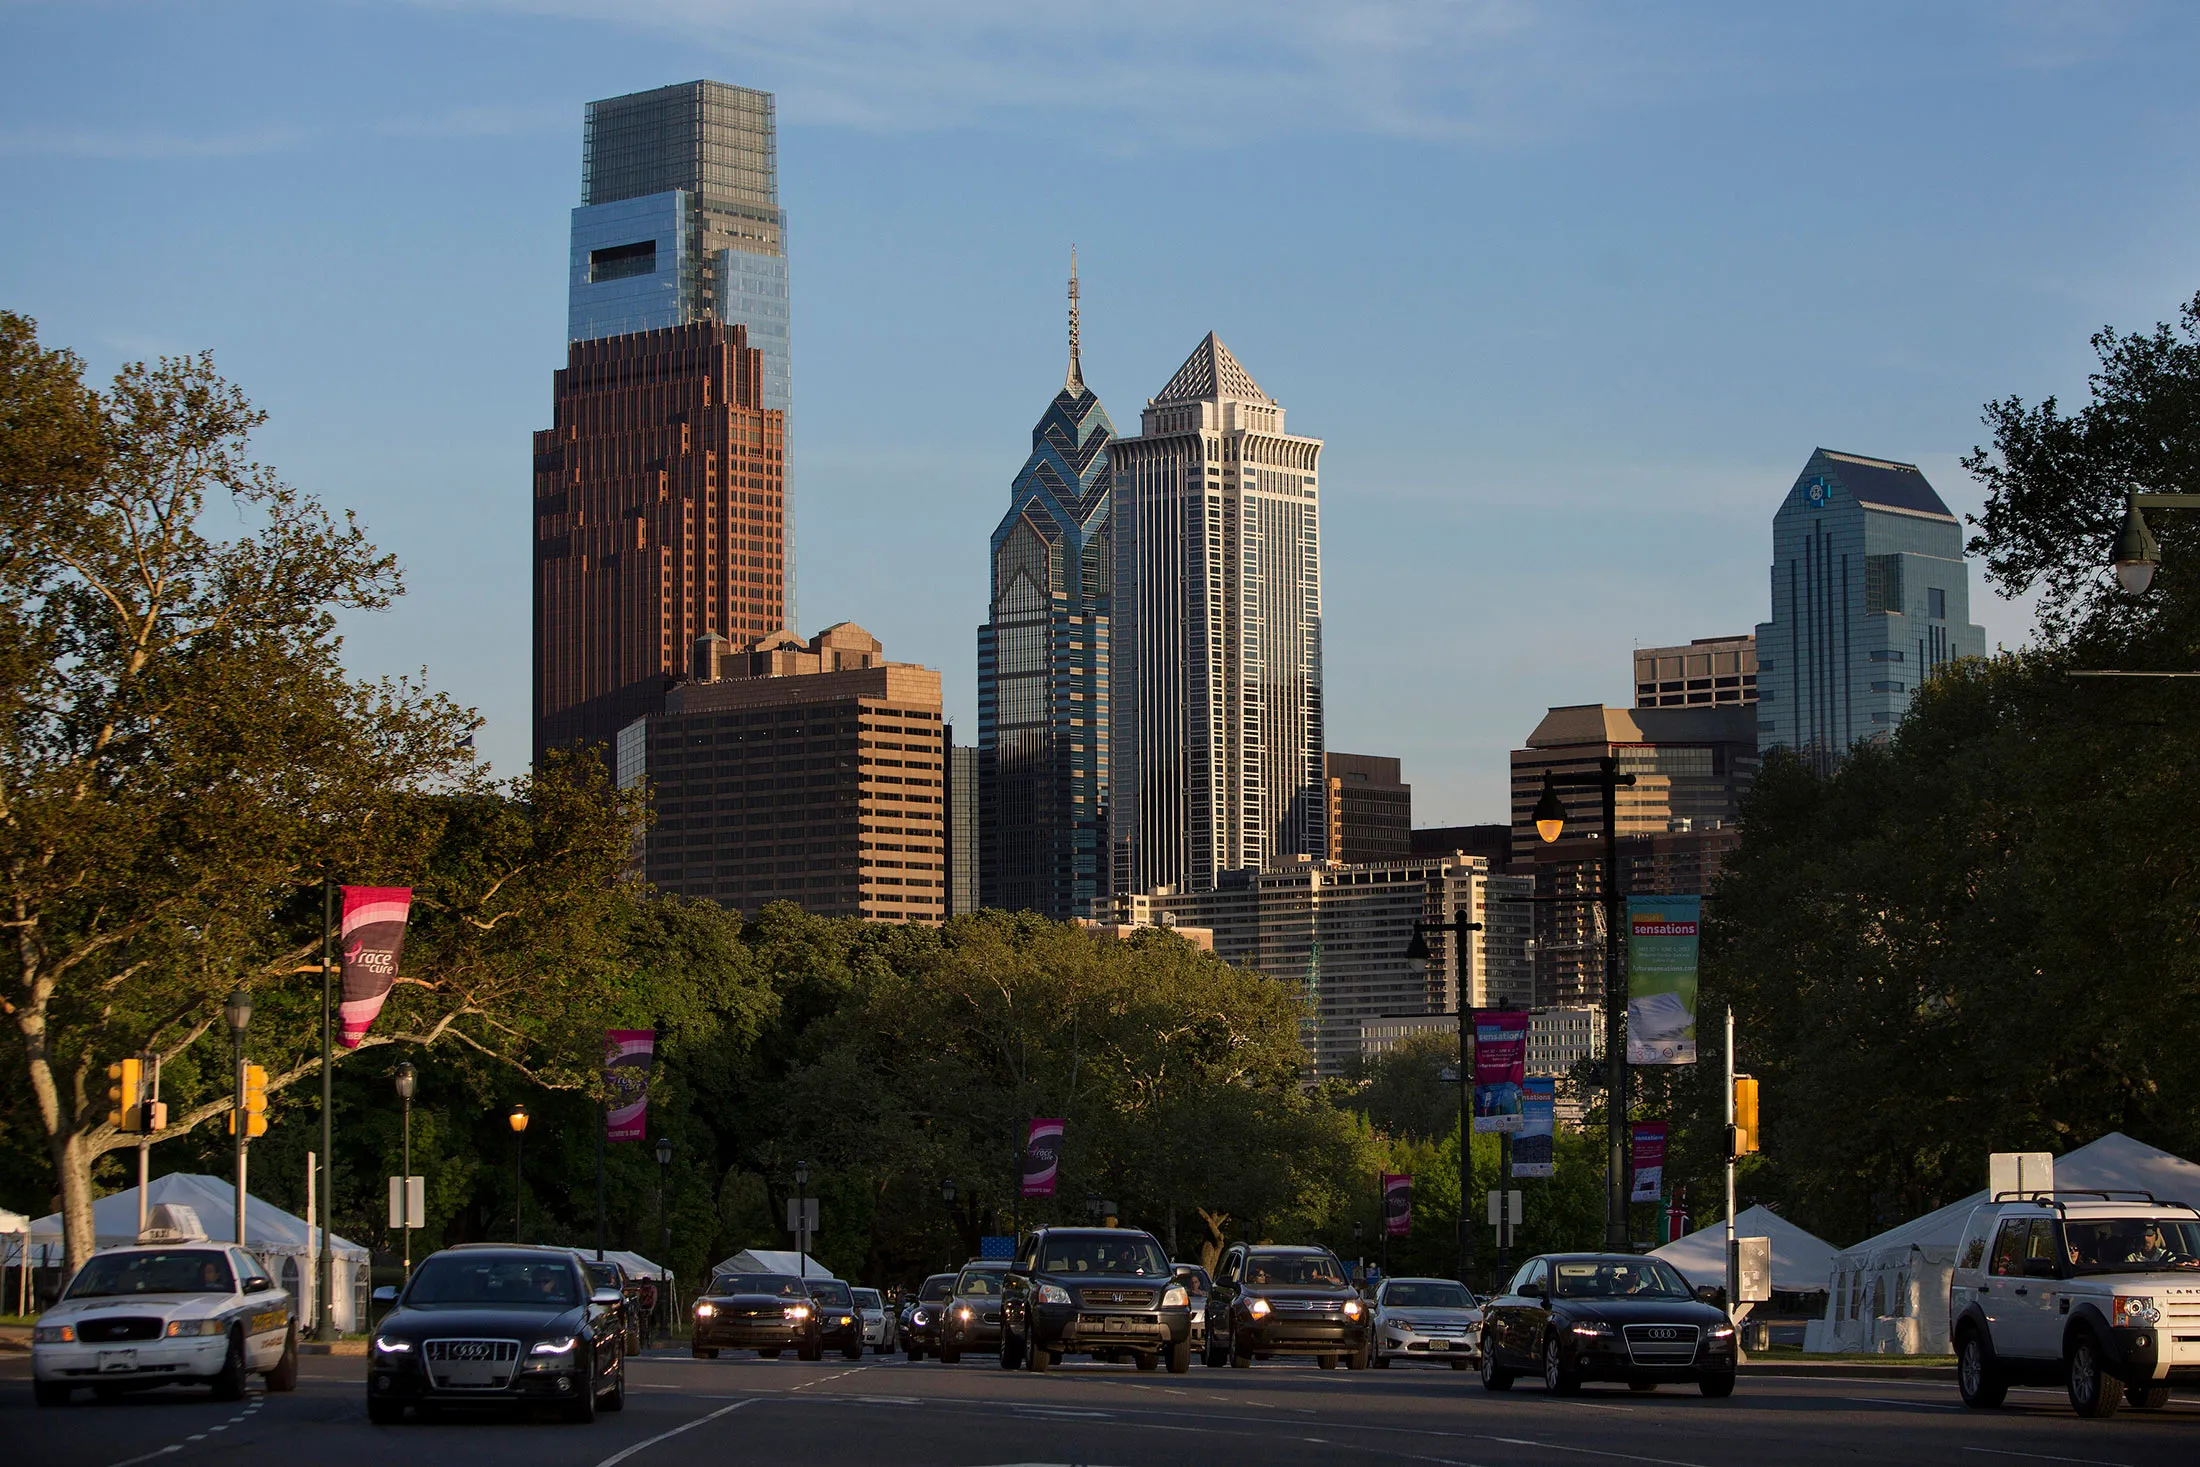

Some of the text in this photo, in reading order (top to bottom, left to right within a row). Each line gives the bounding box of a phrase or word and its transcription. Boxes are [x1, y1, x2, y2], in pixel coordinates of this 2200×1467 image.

[1634, 923, 1695, 934] sensations
[358, 952, 393, 966] race
[369, 964, 394, 975] cure
